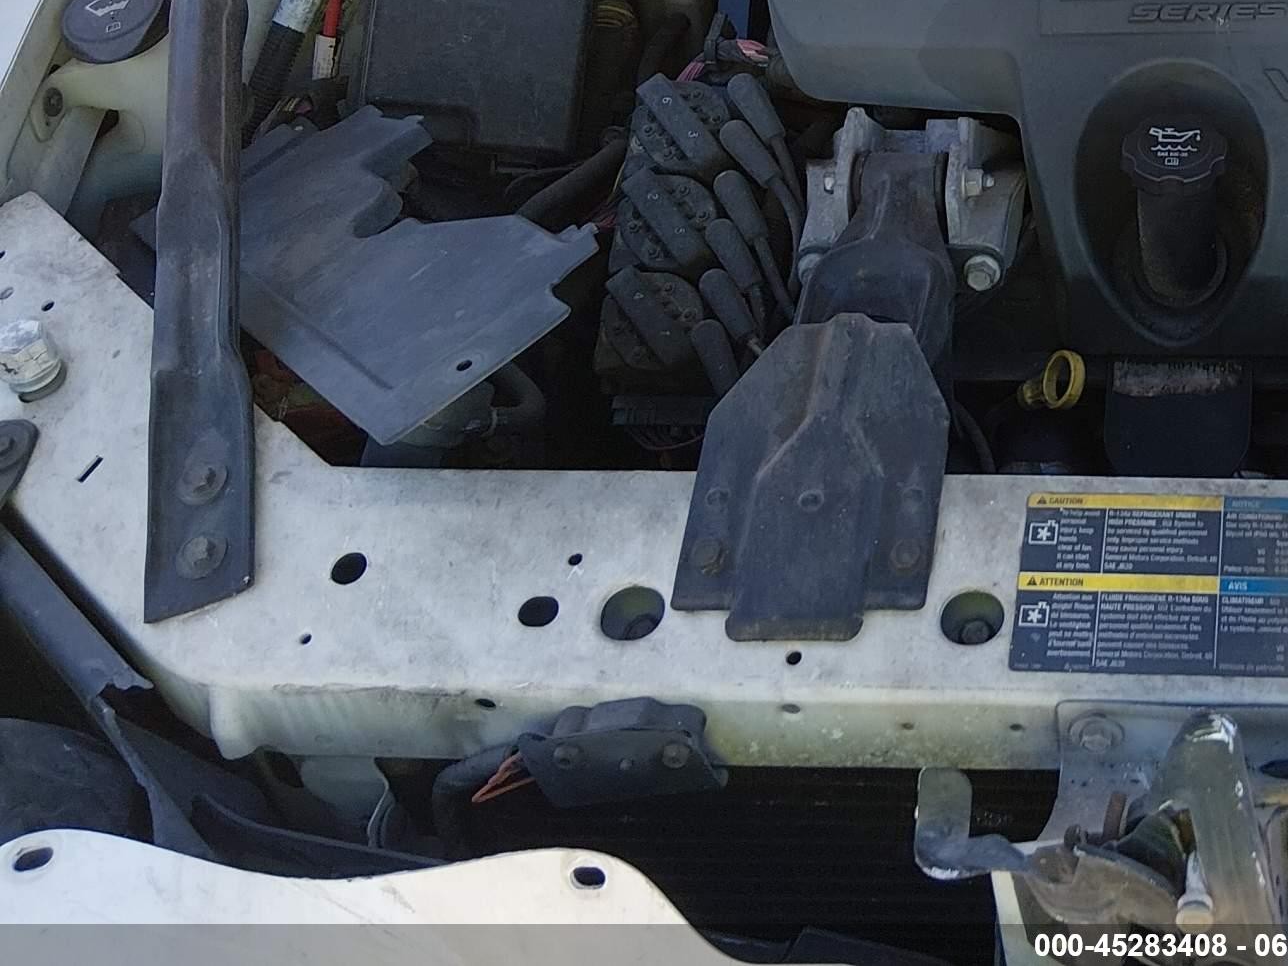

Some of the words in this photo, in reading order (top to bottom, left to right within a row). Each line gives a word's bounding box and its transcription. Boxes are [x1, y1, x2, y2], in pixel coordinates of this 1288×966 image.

[1128, 1, 1286, 23] SERIES
[1049, 497, 1083, 505] CAUTION
[1231, 500, 1260, 508] NOTICE
[1039, 578, 1084, 586] ATTENTION
[1228, 582, 1248, 590] AVIS
